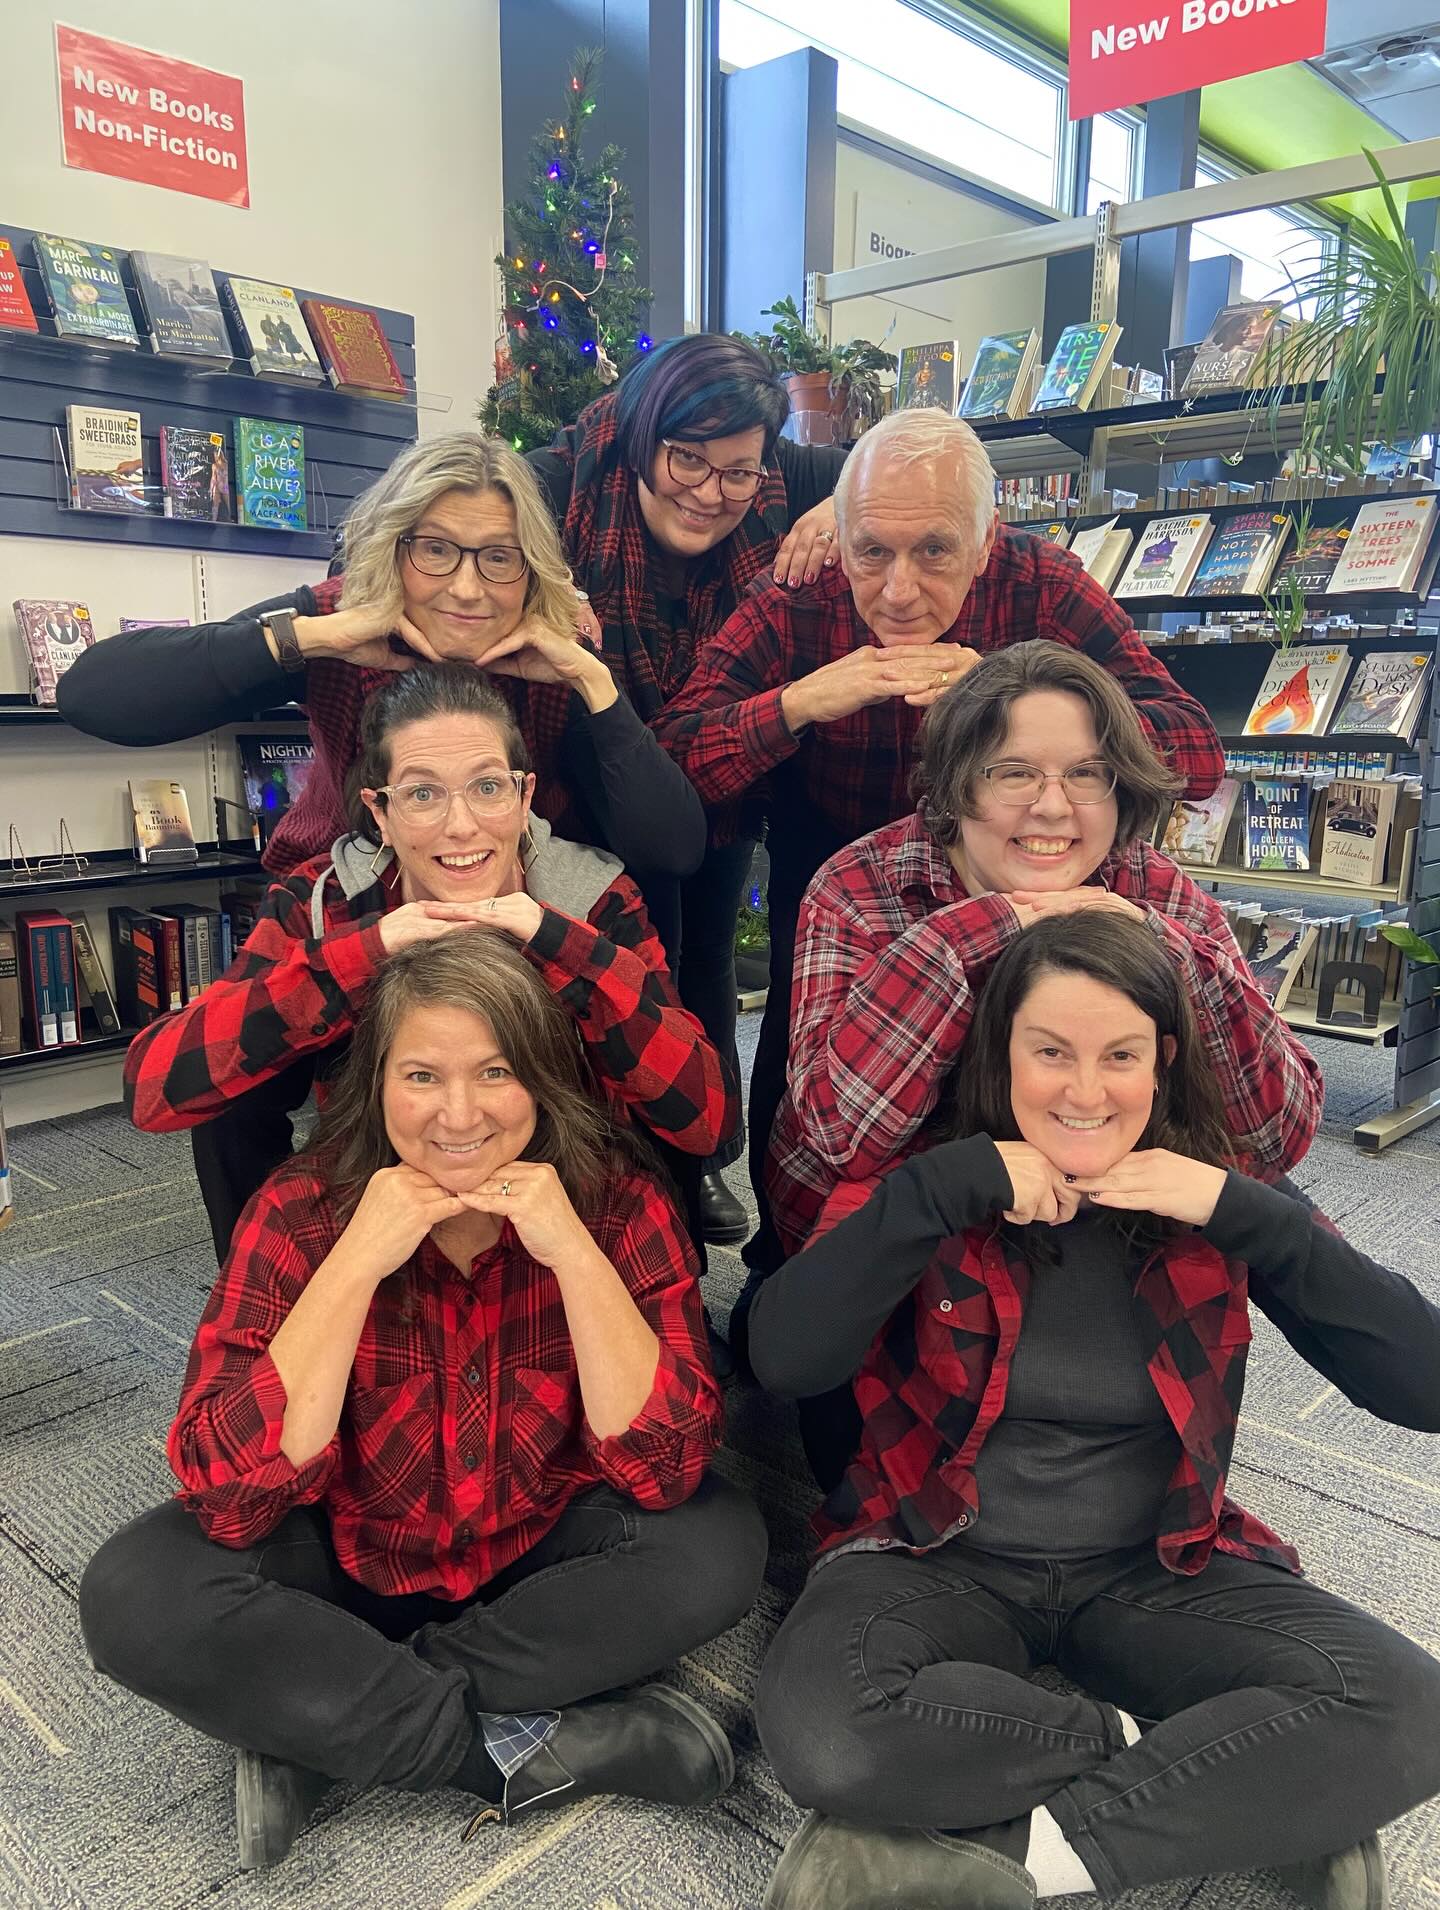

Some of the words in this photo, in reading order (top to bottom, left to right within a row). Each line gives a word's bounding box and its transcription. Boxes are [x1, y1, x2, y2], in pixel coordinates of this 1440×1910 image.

[1091, 16, 1170, 60] New
[1182, 0, 1297, 33] Boo
[73, 65, 140, 105] New
[149, 87, 235, 132] Books
[73, 105, 238, 170] Non-Fiction
[870, 232, 915, 259] Biogr
[48, 247, 84, 263] MARC
[52, 260, 119, 284] GARNEAU
[240, 293, 296, 310] CLANLANDS
[66, 312, 132, 332] EXTRAORDINARY
[107, 311, 130, 322] MOST
[156, 318, 192, 330] Marilyn
[158, 328, 168, 336] in
[170, 329, 220, 342] Manhattan
[906, 353, 940, 364] GREGO
[86, 417, 130, 433] BRAIDING
[80, 429, 136, 446] SWEETGRASS
[280, 438, 288, 449] A
[254, 454, 295, 470] RIVER
[251, 476, 300, 492] ALIVE?
[1359, 519, 1416, 534] SIXTEEN
[1220, 540, 1247, 552] NOT
[1250, 539, 1258, 547] A
[1362, 535, 1402, 548] TREES
[1214, 551, 1257, 562] HAPPY
[1346, 557, 1398, 570] SOMME
[1208, 563, 1248, 574] FAMIL
[1122, 581, 1148, 592] PLAY
[52, 652, 81, 660] CLANLAN
[260, 745, 316, 758] NIGHTW
[1255, 787, 1300, 802] POINT
[1272, 804, 1283, 814] OF
[152, 816, 182, 824] Book
[1251, 816, 1304, 830] RETREAT
[1261, 836, 1294, 844] COLLEEN
